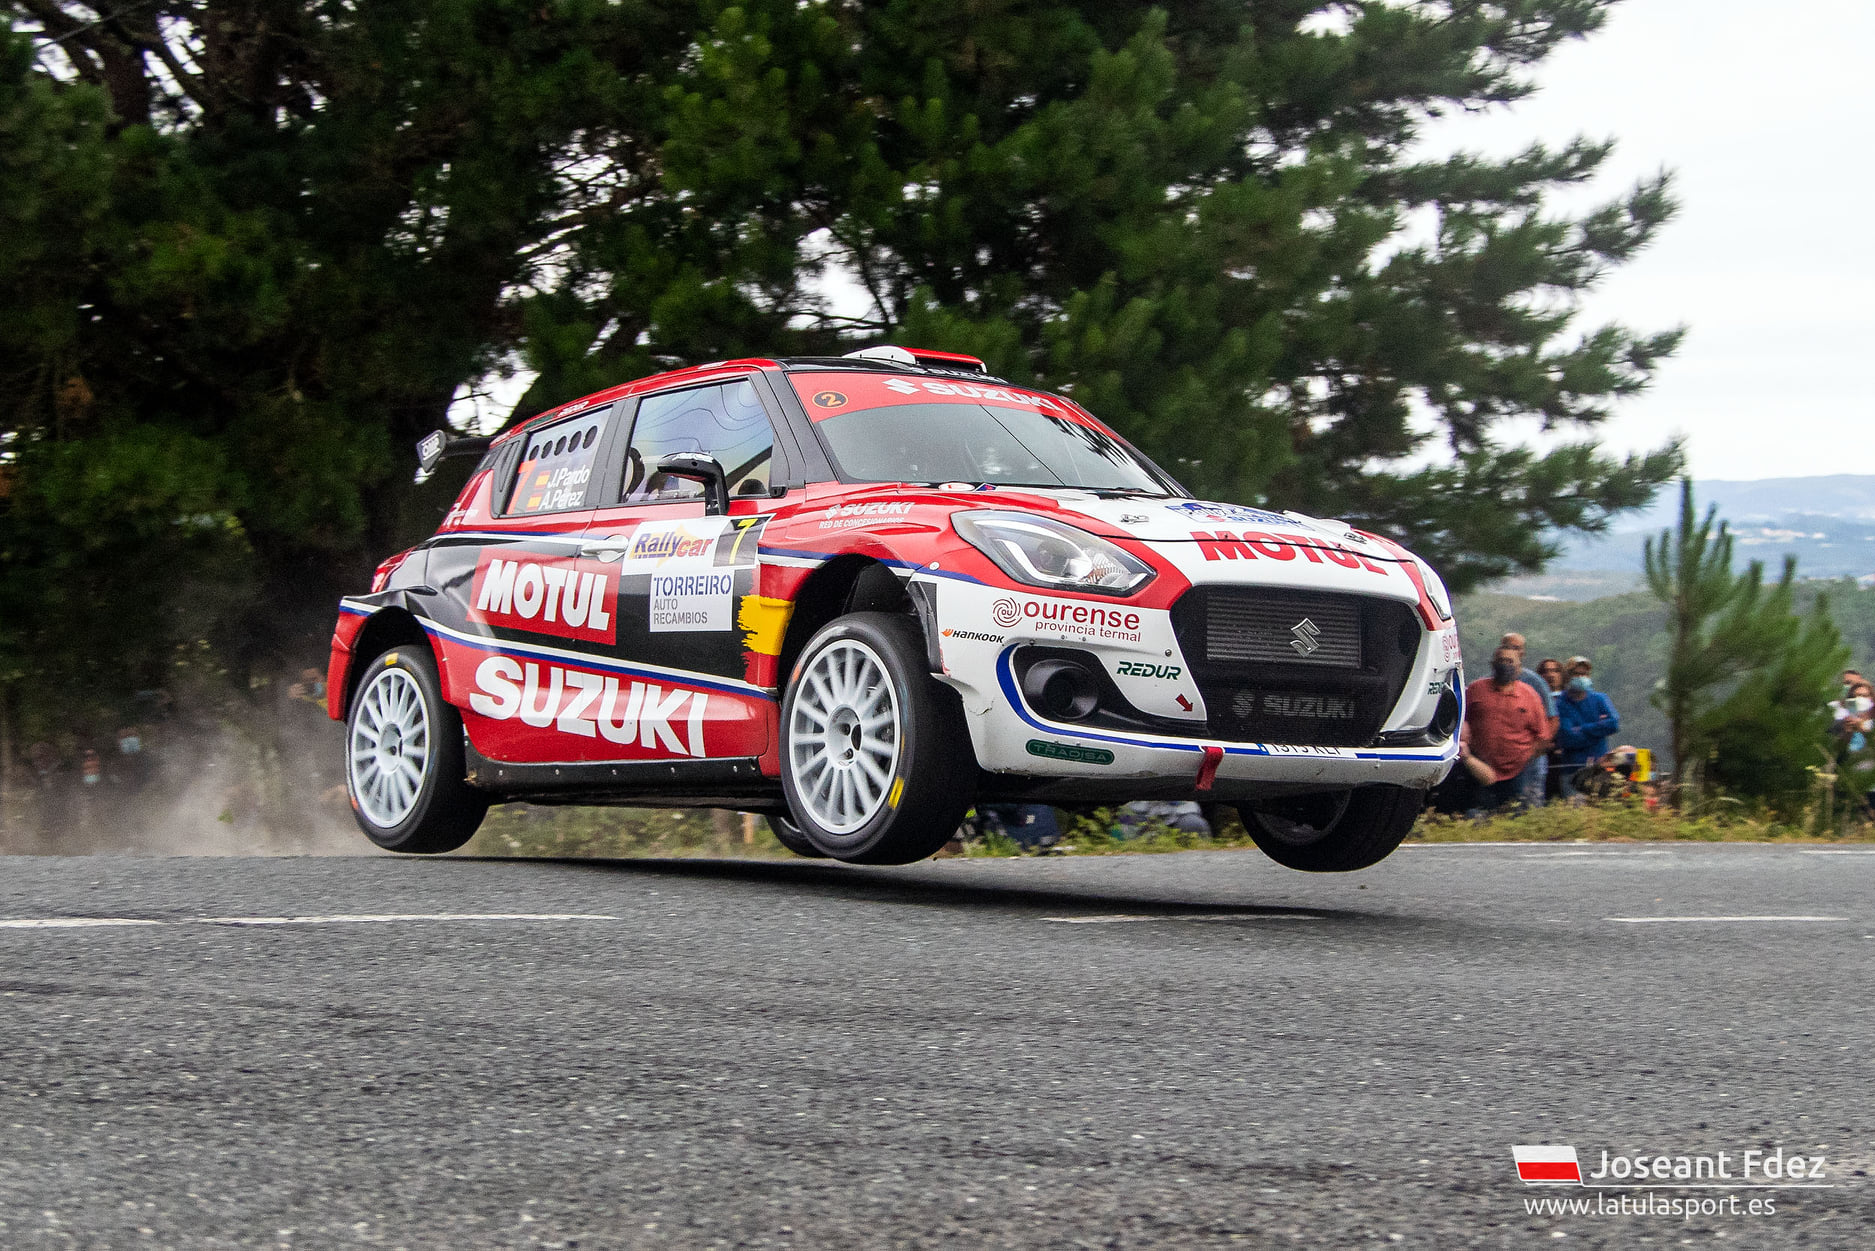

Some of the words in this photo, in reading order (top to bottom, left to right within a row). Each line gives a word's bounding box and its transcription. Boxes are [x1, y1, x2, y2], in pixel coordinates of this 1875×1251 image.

[820, 393, 842, 407] 2
[922, 382, 1064, 413] SUZUKI
[547, 465, 591, 488] J.Pardo
[841, 501, 916, 517] SUZUKI
[819, 520, 834, 529] RED
[834, 519, 844, 528] DE
[634, 532, 715, 558] Rallycar
[728, 518, 759, 565] 7
[1190, 530, 1389, 577] MOTUL
[476, 558, 610, 631] MOTUL
[653, 574, 732, 597] TORREIRO
[653, 598, 678, 611] AUTO
[1023, 600, 1141, 630] ourense
[653, 611, 708, 625] RECAMBIOS
[1035, 620, 1096, 637] provincia
[1100, 626, 1141, 643] termal
[1116, 661, 1182, 681] REDUR
[469, 655, 709, 758] SUZUKI
[1263, 693, 1355, 719] SUZUKI
[1033, 743, 1108, 762] TRADISA
